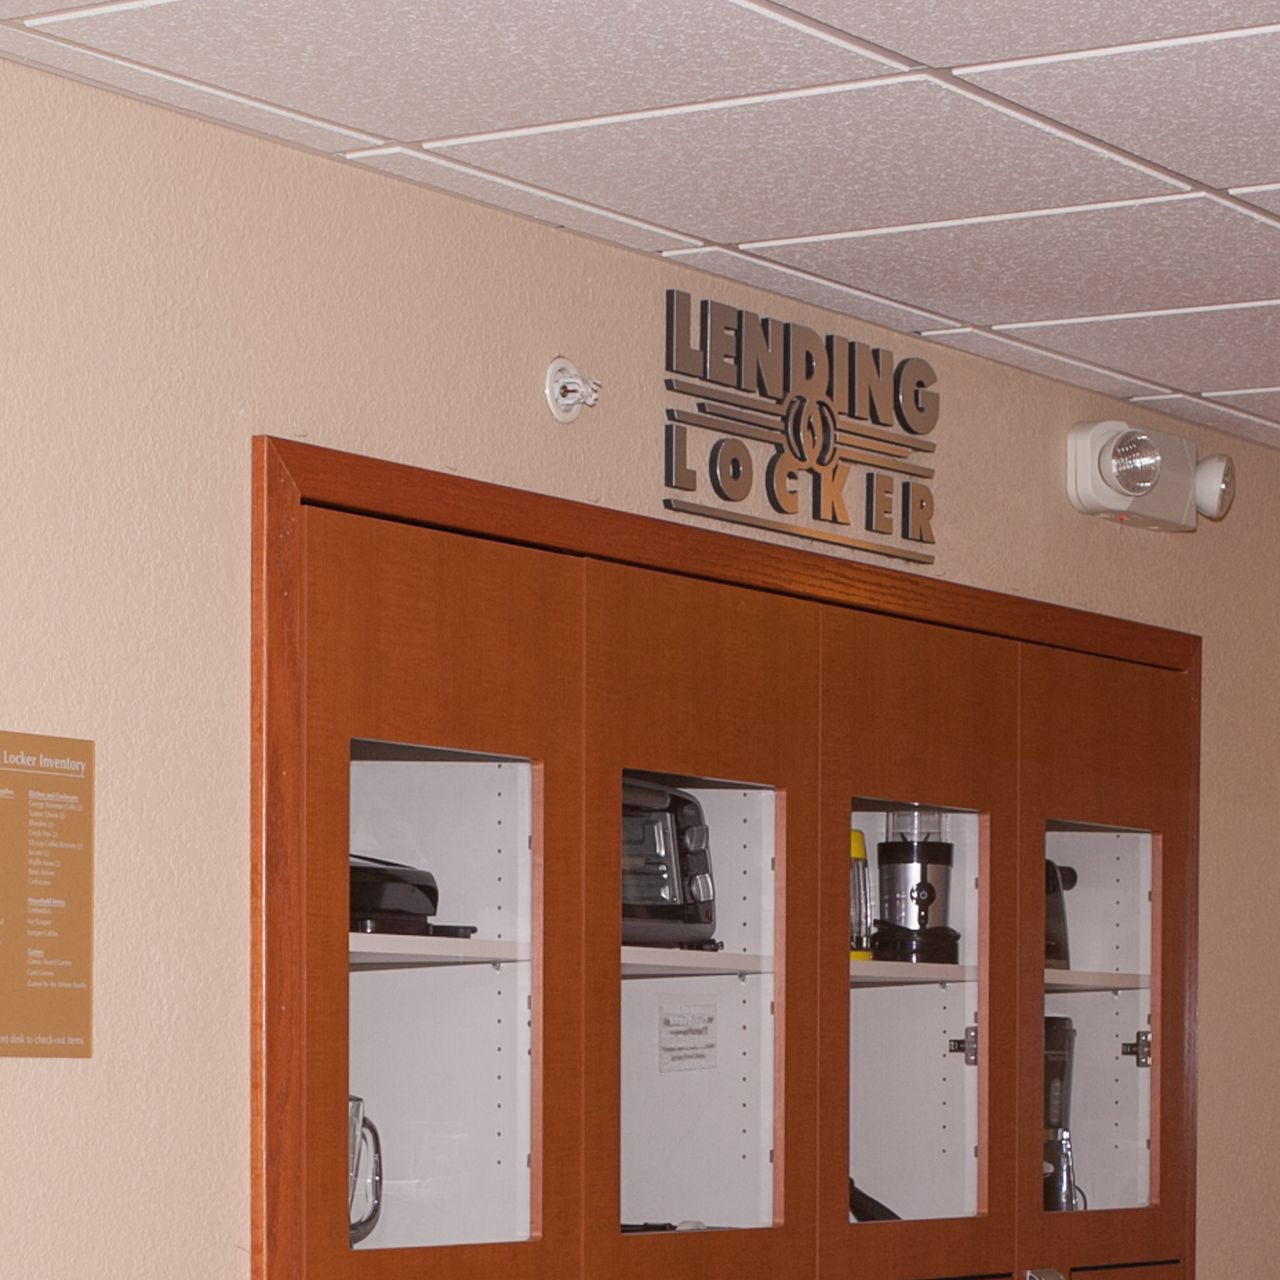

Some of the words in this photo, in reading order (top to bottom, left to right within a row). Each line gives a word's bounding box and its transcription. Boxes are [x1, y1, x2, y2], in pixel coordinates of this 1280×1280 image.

[665, 289, 940, 435] LENDING
[665, 424, 936, 545] LOCKER
[3, 750, 37, 766] Locker
[39, 754, 86, 776] Inventory
